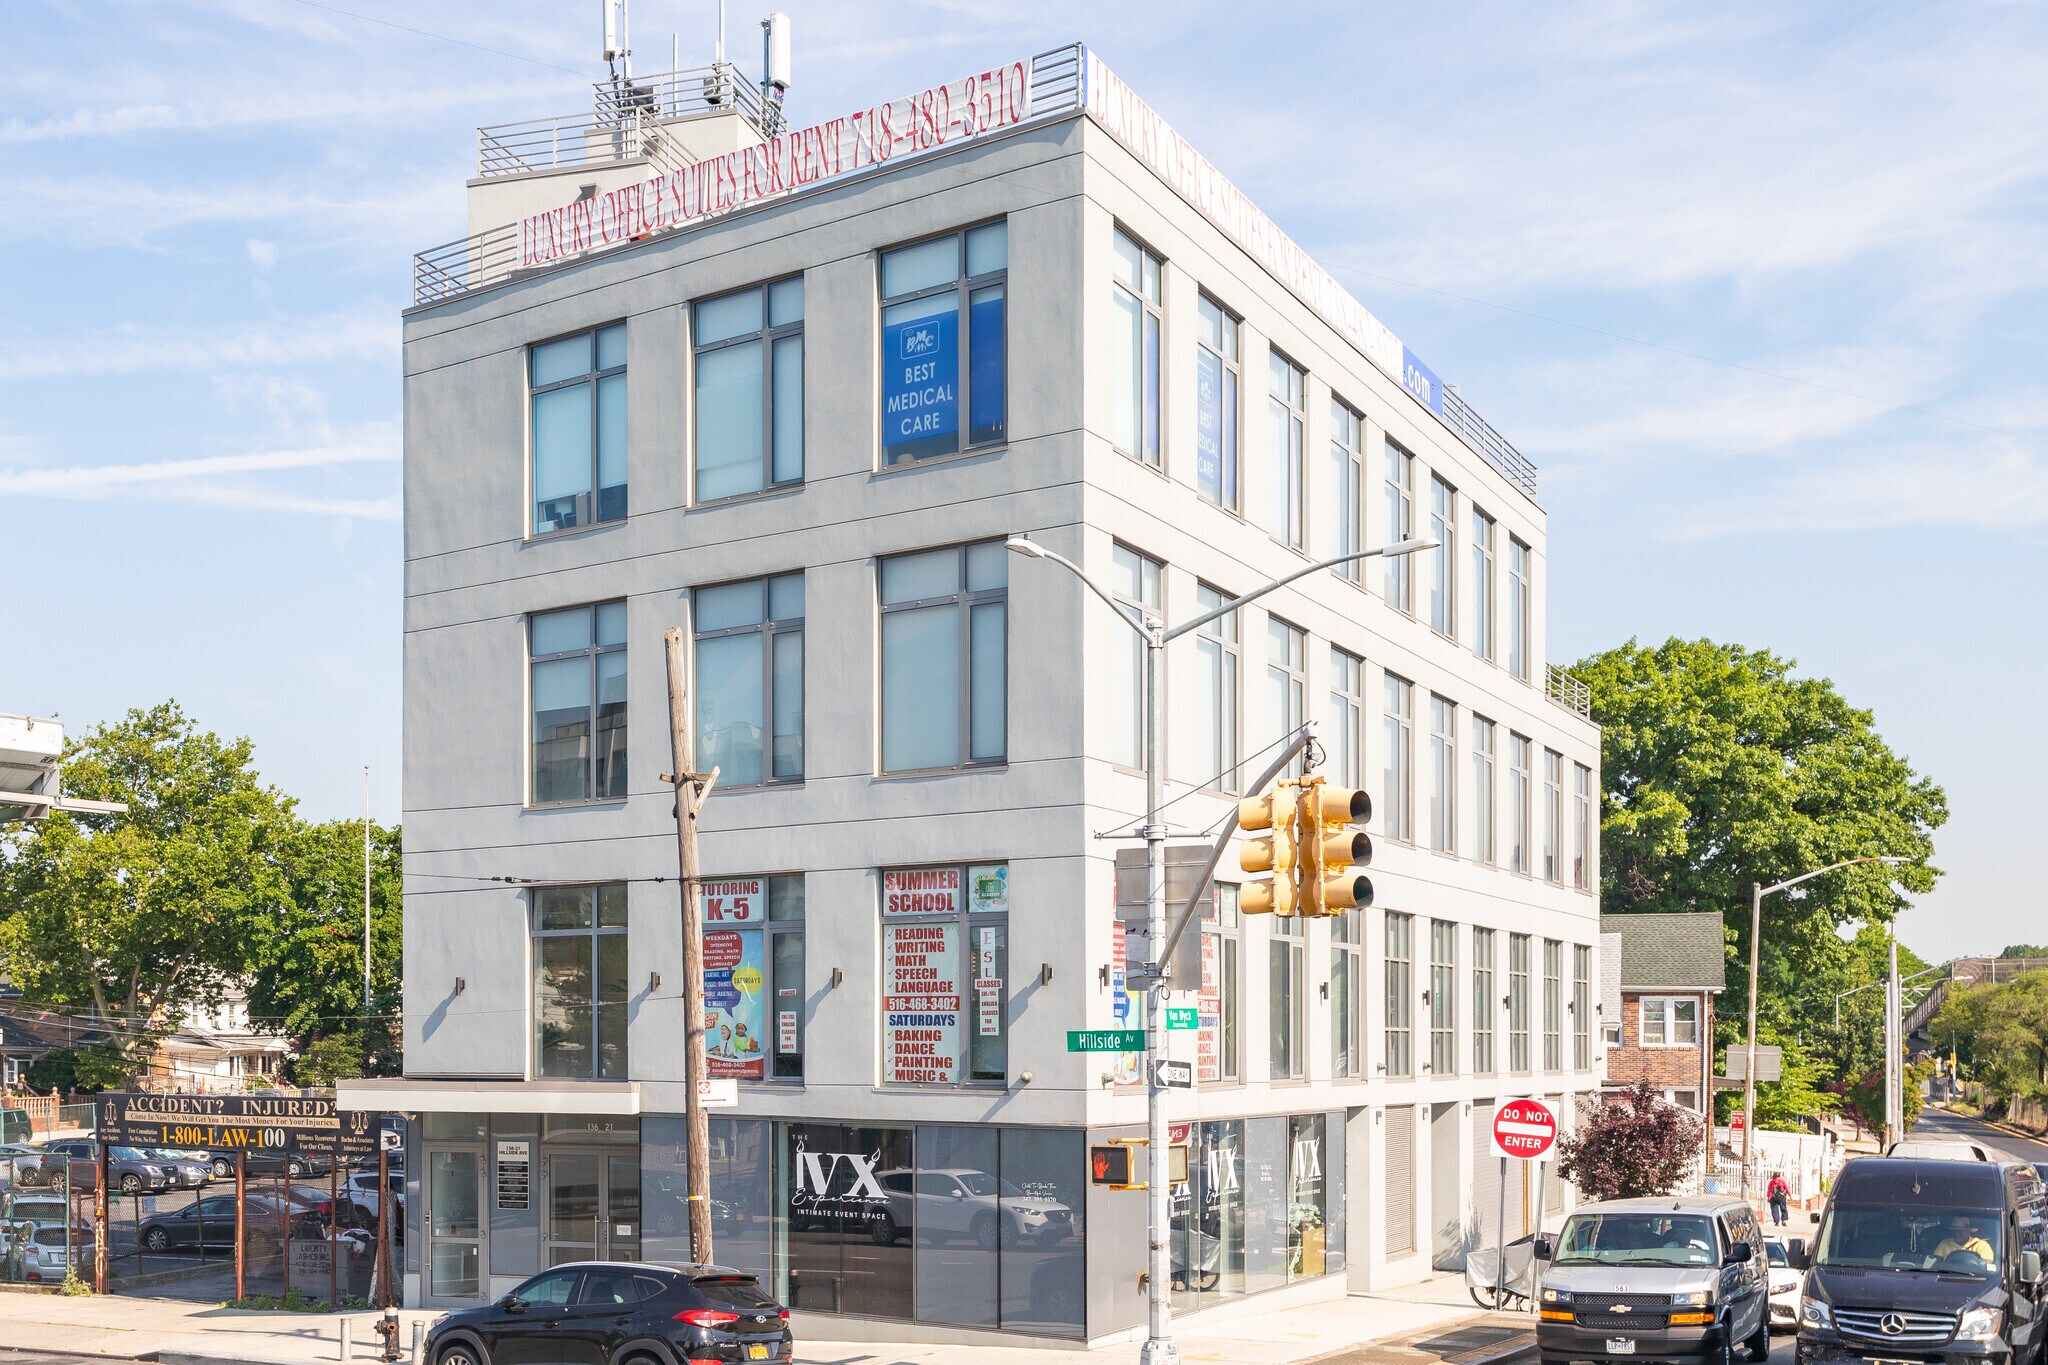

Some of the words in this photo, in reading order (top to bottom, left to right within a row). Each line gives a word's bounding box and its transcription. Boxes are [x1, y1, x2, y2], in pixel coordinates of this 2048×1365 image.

[1095, 58, 1161, 169] LUXURY
[523, 197, 597, 266] LUXURY
[601, 176, 666, 243] OFFICE
[671, 152, 736, 223] SUITES
[743, 137, 784, 200] FOR
[789, 118, 845, 187] RENT
[852, 61, 1024, 168] 718-480-3510
[905, 362, 936, 384] BEST
[888, 384, 953, 413] MEDICAL
[901, 412, 940, 435] CARE
[1200, 409, 1212, 430] BEST
[1199, 432, 1219, 458] EDICAL
[1199, 456, 1214, 479] CARE
[885, 870, 959, 891] SUMMER
[701, 881, 759, 896] TUTORING
[707, 897, 750, 920] K-5
[888, 893, 955, 913] SCHOOL
[895, 928, 944, 940] READING
[895, 941, 945, 953] WRITING
[895, 955, 927, 967] MATH
[895, 968, 938, 980] SPEECH
[895, 981, 954, 993] LANGUAGE
[976, 980, 1001, 988] CLASSES
[888, 997, 957, 1011] 516-468-3402
[705, 1012, 718, 1020] OIN
[888, 1014, 956, 1026] SATURDAYS
[1169, 1009, 1178, 1020] Van
[895, 1030, 942, 1042] BAKING
[1079, 1033, 1120, 1049] Hillside
[1125, 1033, 1135, 1042] Av
[895, 1043, 935, 1055] DANCE
[895, 1057, 953, 1069] PAINTING
[895, 1070, 936, 1081] MUSIC
[939, 1071, 948, 1081] &
[1167, 1068, 1177, 1080] ONE
[1179, 1069, 1188, 1080] WAY
[126, 1096, 225, 1115] ACCIDENT?
[242, 1100, 338, 1117] INJURED?
[155, 1113, 169, 1121] Now!
[195, 1115, 206, 1123] Get
[207, 1116, 219, 1124] You
[221, 1116, 234, 1124] The
[252, 1117, 275, 1126] Money
[306, 1119, 335, 1127] Injuries.
[1503, 1108, 1520, 1120] DO
[1526, 1110, 1549, 1123] NOT
[587, 1123, 598, 1131] 136
[605, 1123, 613, 1131] 21
[161, 1125, 285, 1148] 1-800-LAW-100
[1504, 1135, 1542, 1149] ENTER
[792, 1187, 892, 1210] Experience
[797, 1208, 831, 1216] INTIMATE
[835, 1210, 858, 1218] EVENT
[862, 1212, 886, 1220] SPACE
[301, 1244, 327, 1253] LIBERTY
